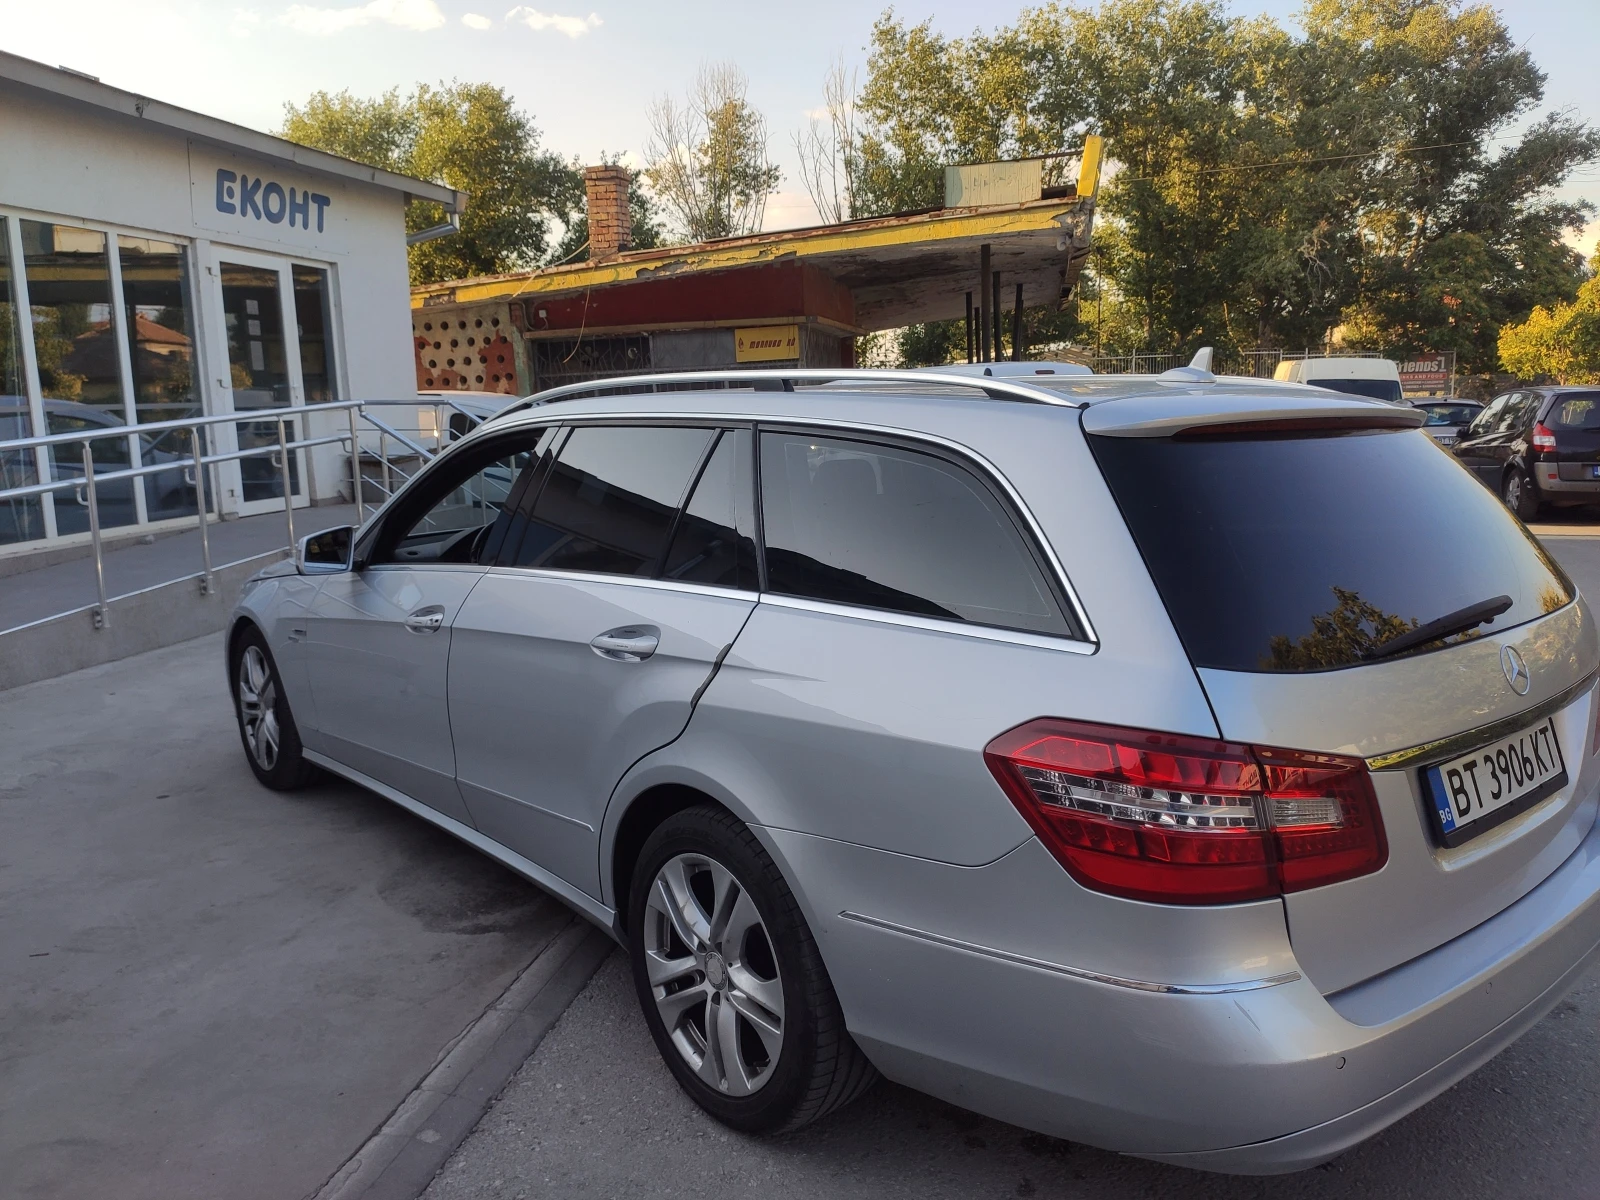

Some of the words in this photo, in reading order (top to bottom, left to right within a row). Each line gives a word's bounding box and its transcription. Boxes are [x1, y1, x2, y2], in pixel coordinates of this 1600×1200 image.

[216, 168, 331, 234] ЕКОНТ
[1439, 809, 1452, 824] BG
[1446, 759, 1484, 818] BT
